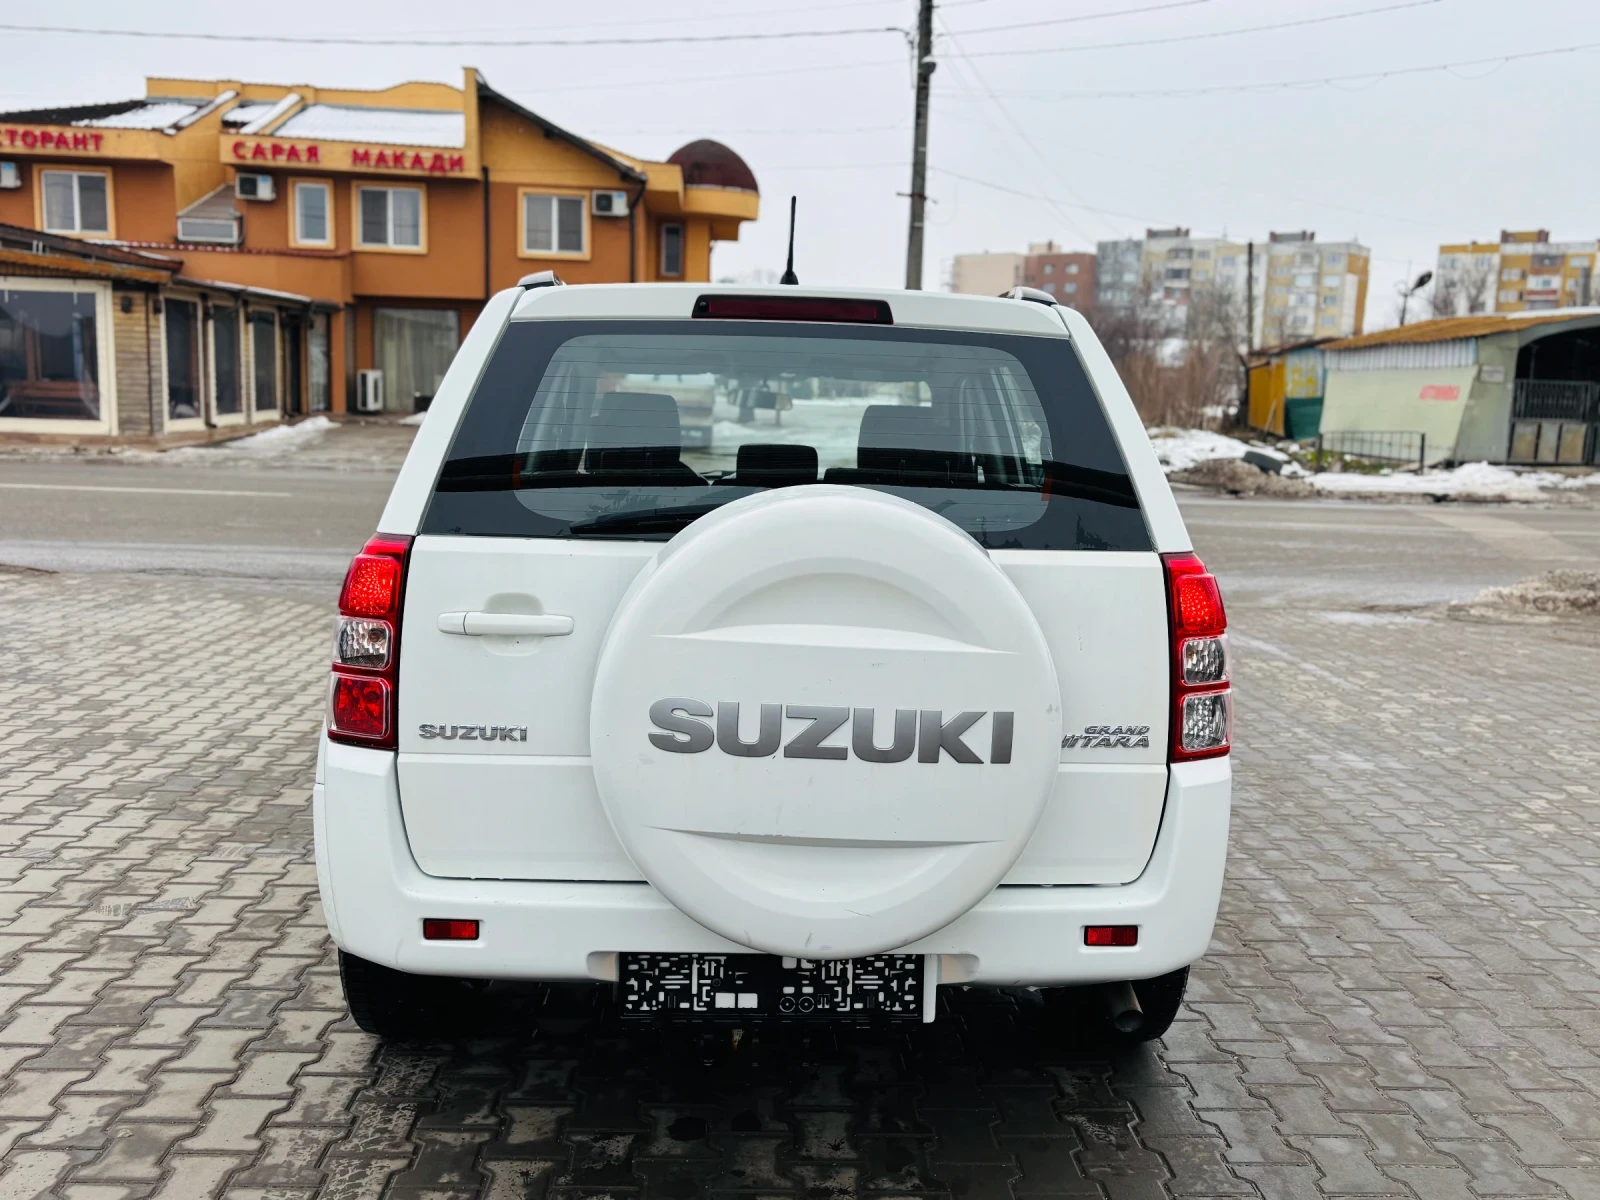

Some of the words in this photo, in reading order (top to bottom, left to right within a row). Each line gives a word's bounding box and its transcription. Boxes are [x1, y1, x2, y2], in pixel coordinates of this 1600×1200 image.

[0, 128, 103, 152] ТОРАНТ
[232, 141, 320, 163] САРАЯ
[352, 148, 464, 173] МАКАДИ
[418, 723, 528, 742] SUZUKI
[648, 696, 1014, 764] SUZUKI
[1084, 725, 1150, 735] GRAND
